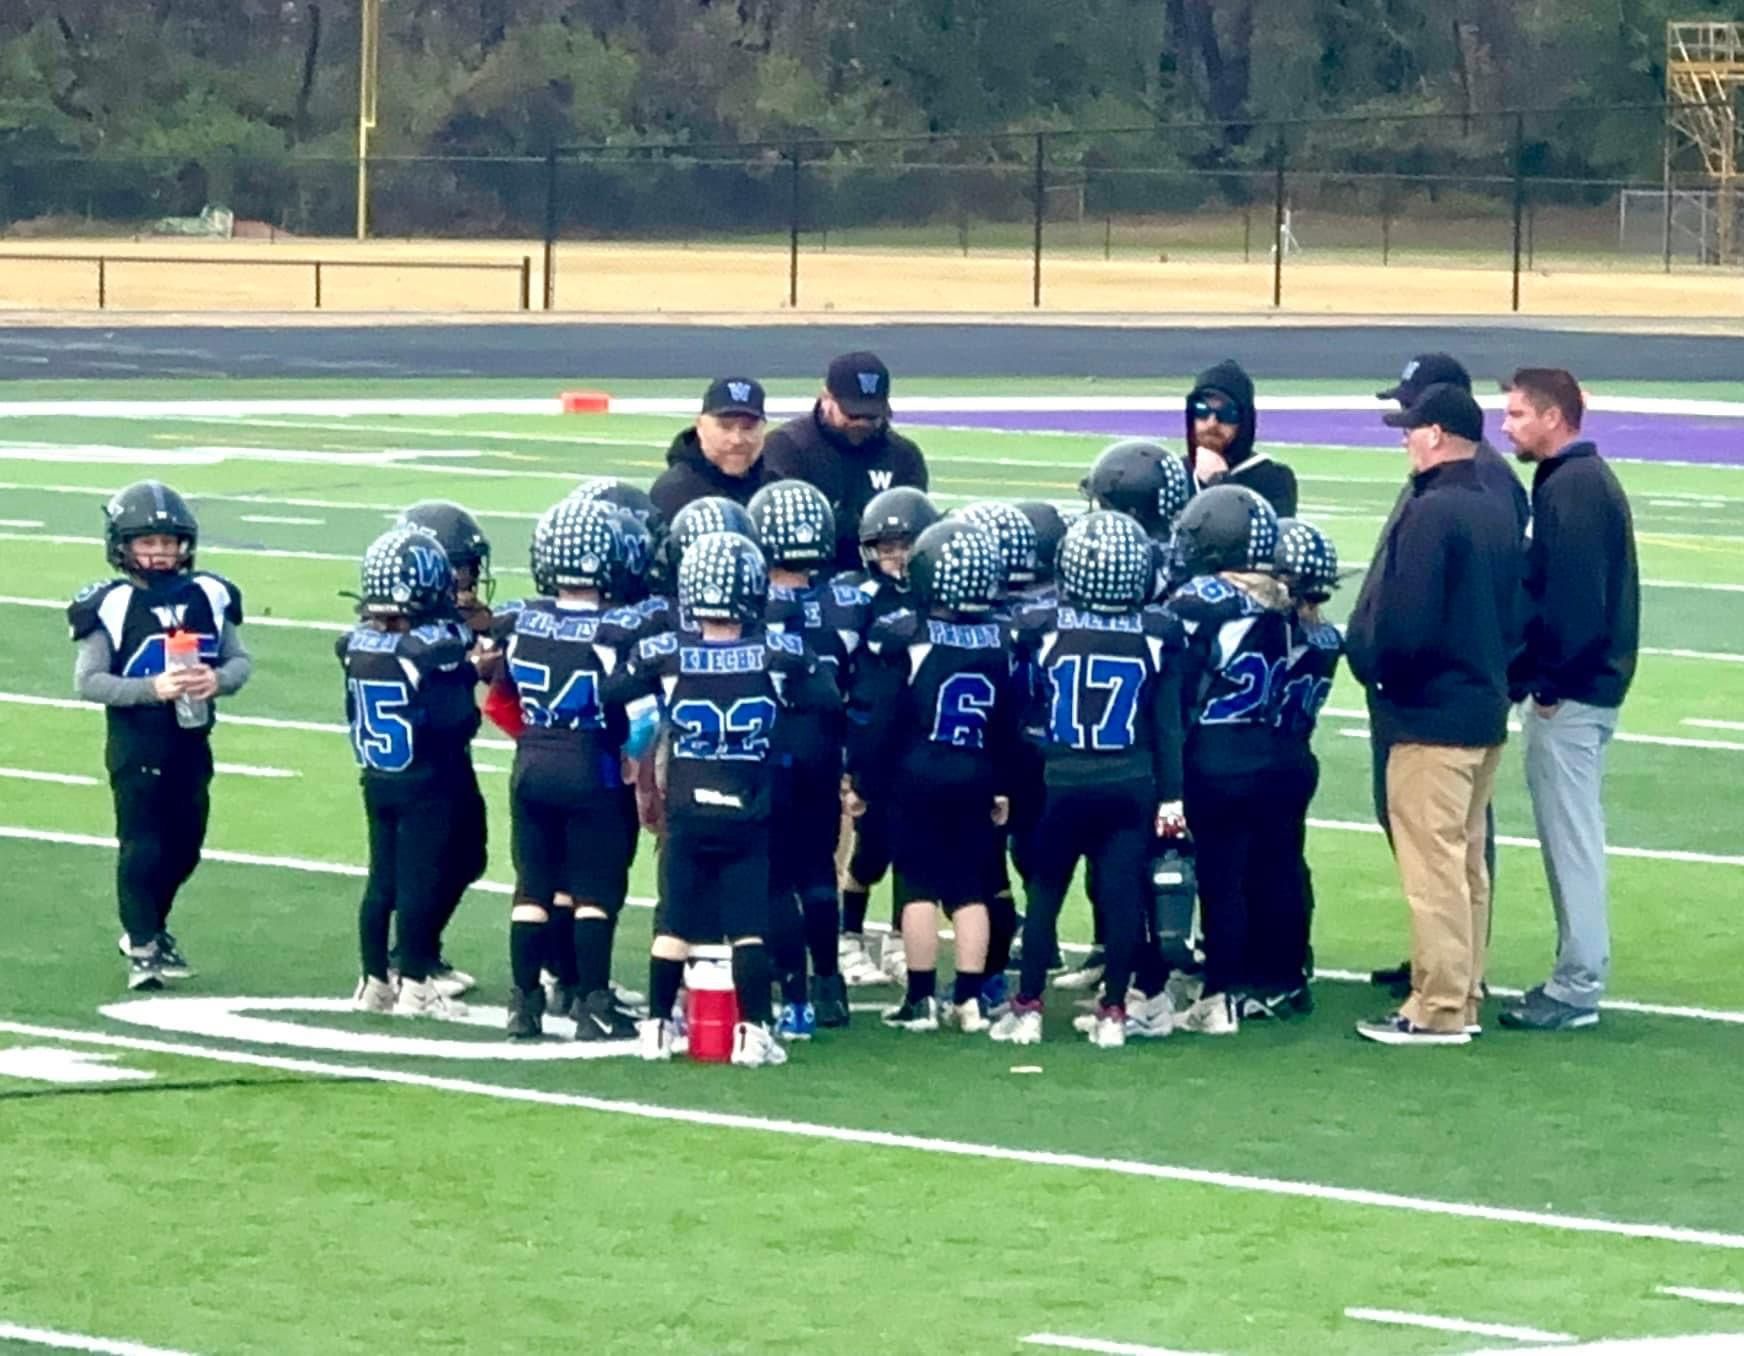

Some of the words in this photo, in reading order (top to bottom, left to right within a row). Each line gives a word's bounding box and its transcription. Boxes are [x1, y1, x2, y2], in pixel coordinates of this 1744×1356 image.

[727, 382, 751, 402] W
[857, 373, 880, 394] W
[868, 470, 893, 490] W
[151, 604, 188, 628] W
[509, 657, 608, 731] 54
[929, 672, 996, 749] 6
[1048, 654, 1147, 750] 17
[671, 696, 777, 762] 22
